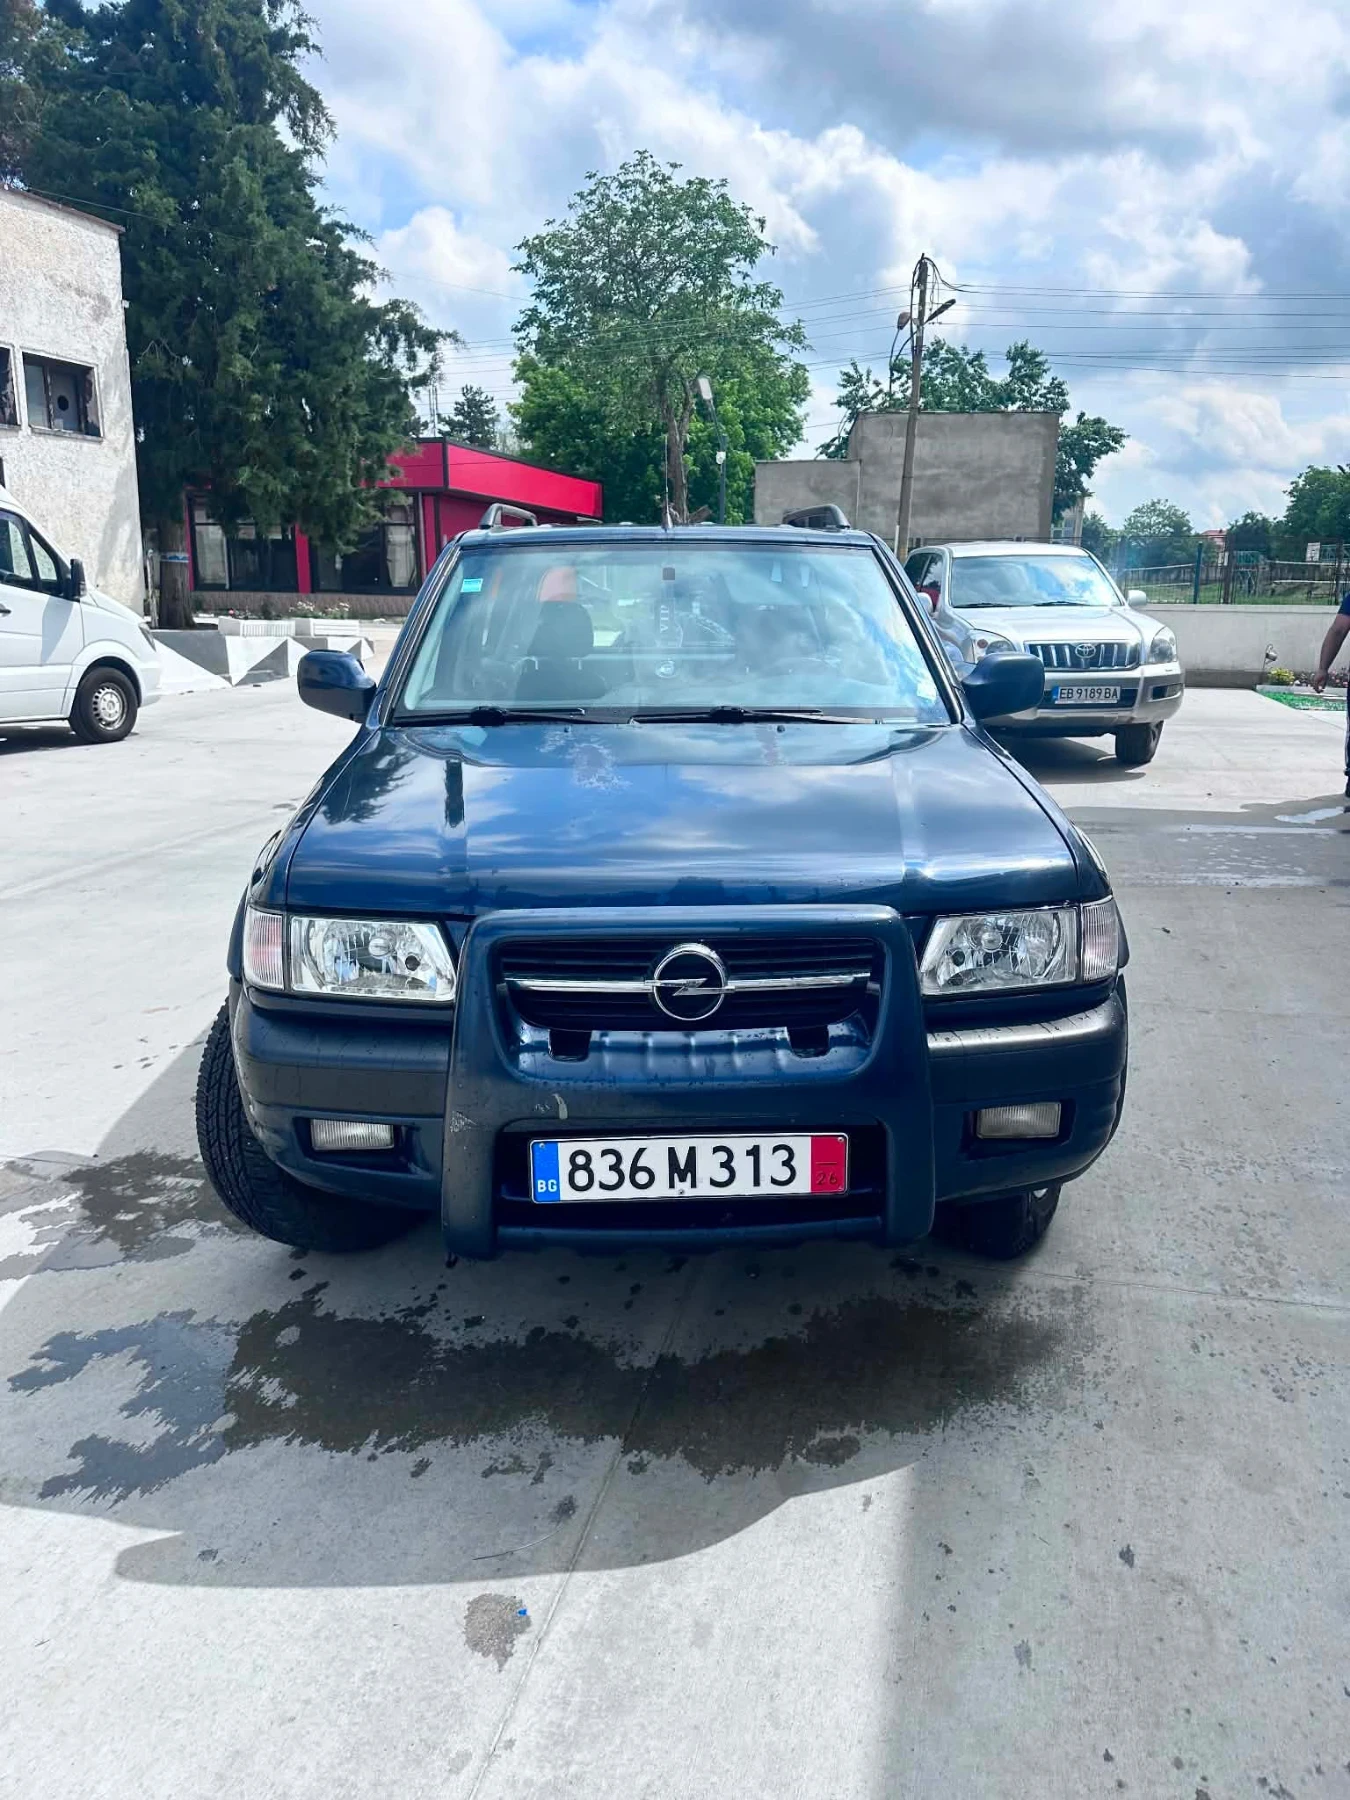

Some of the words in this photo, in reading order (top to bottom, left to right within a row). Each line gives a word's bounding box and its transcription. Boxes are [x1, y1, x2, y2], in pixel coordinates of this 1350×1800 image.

[1060, 688, 1074, 699] EB
[1076, 688, 1102, 699] 9189
[1104, 688, 1118, 699] BA
[568, 1147, 656, 1192] 836
[667, 1145, 697, 1189] M
[709, 1143, 797, 1188] 313
[815, 1171, 838, 1186] 26
[537, 1179, 558, 1193] BG
